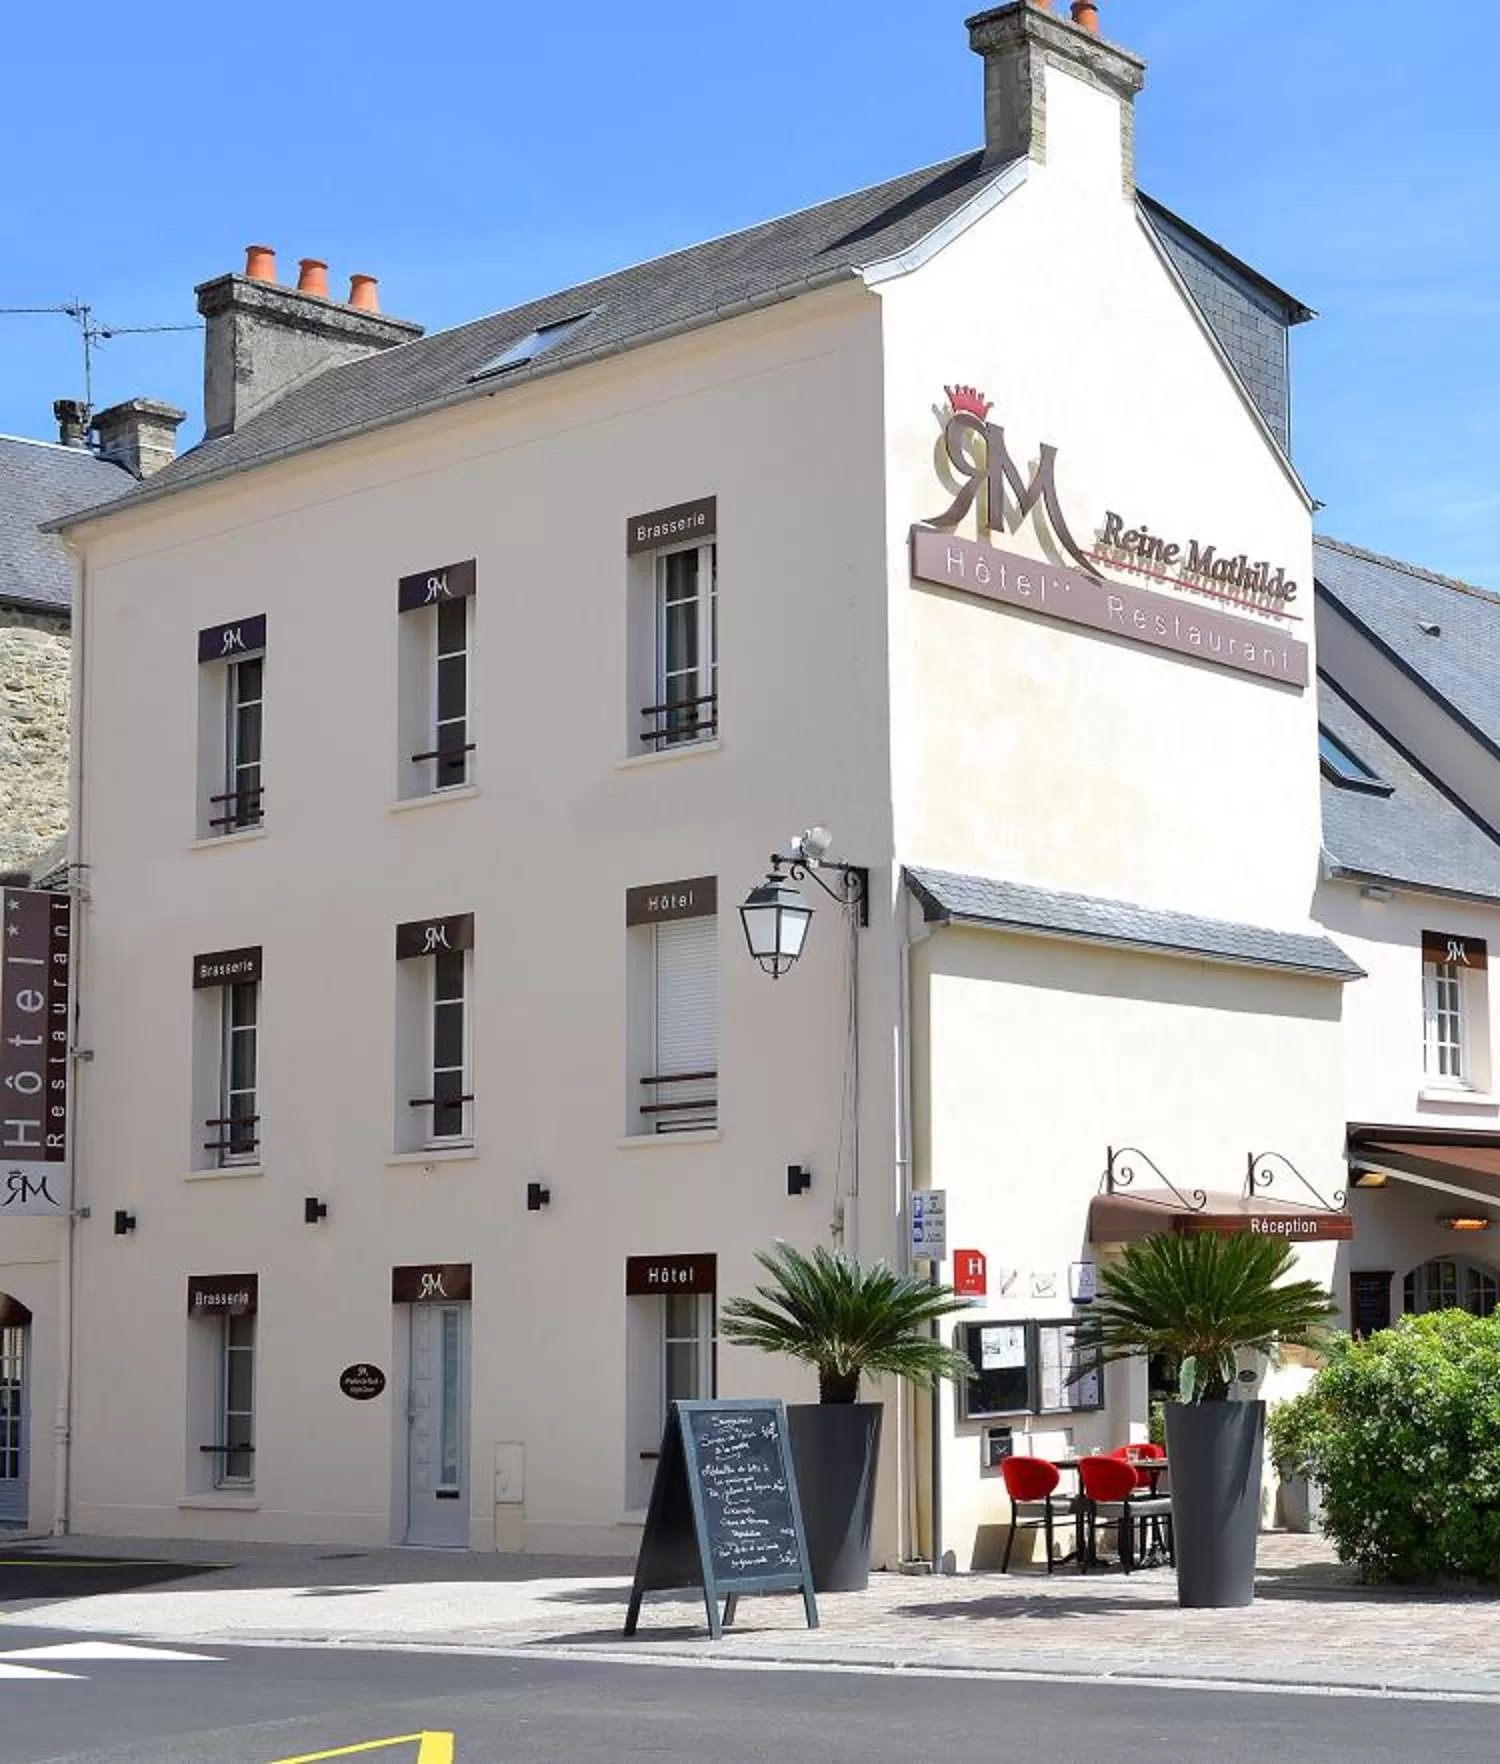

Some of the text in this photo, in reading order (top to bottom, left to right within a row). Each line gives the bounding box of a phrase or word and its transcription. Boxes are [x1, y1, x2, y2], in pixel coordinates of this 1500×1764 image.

[637, 511, 705, 541] Brasserie
[1100, 511, 1298, 603] Reine Mathilde
[1108, 595, 1290, 670] Restaurant
[648, 889, 693, 911] Hôtel
[200, 960, 253, 978] Brasserie
[46, 902, 69, 1147] Restaurant
[3, 956, 45, 1147] Hôtel
[1250, 1217, 1317, 1237] Réception
[648, 1266, 693, 1283] Hôtel
[968, 1258, 983, 1276] H
[195, 1290, 249, 1305] Brasserie
